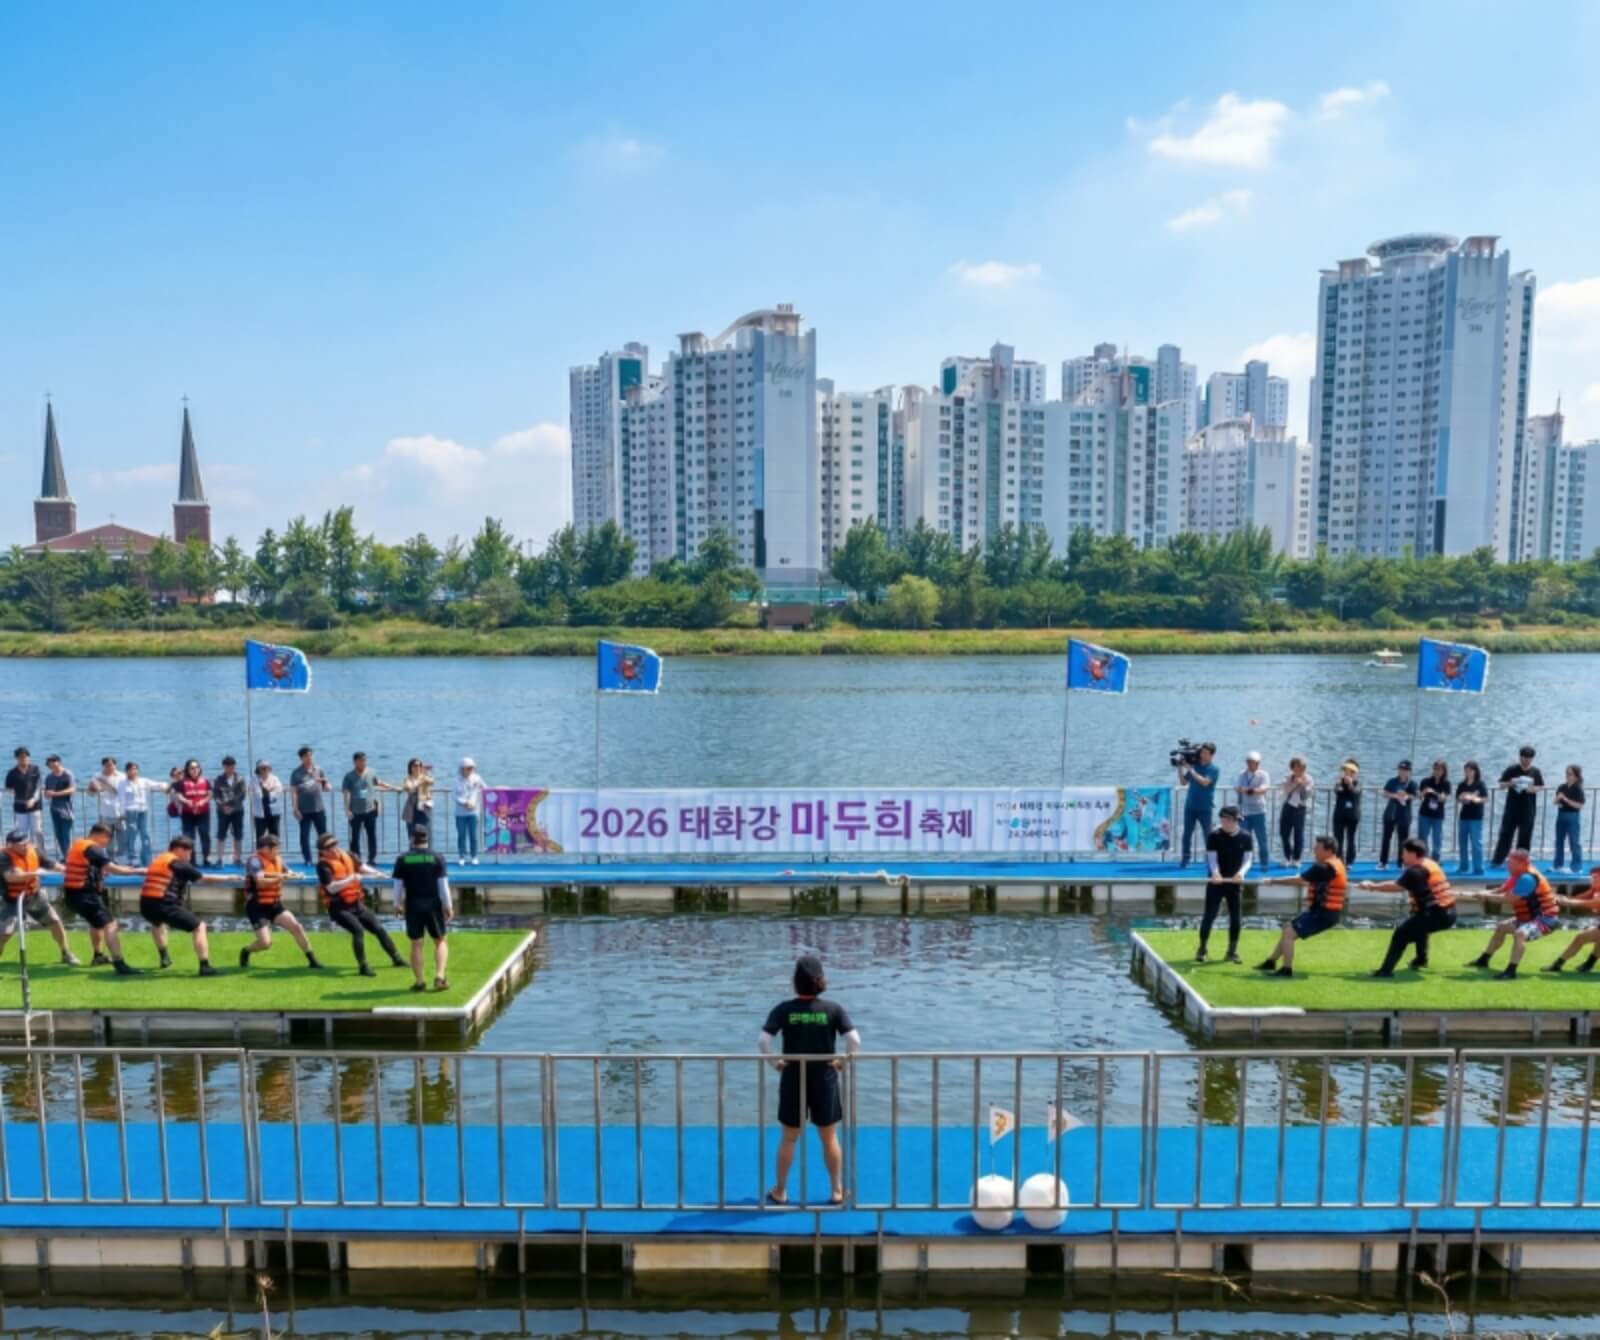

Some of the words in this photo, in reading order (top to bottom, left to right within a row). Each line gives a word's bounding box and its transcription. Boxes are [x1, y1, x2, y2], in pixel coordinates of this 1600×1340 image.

[580, 807, 669, 838] 2026
[679, 805, 781, 841] 태화강
[791, 799, 912, 840] 마두희
[918, 809, 974, 839] 축제
